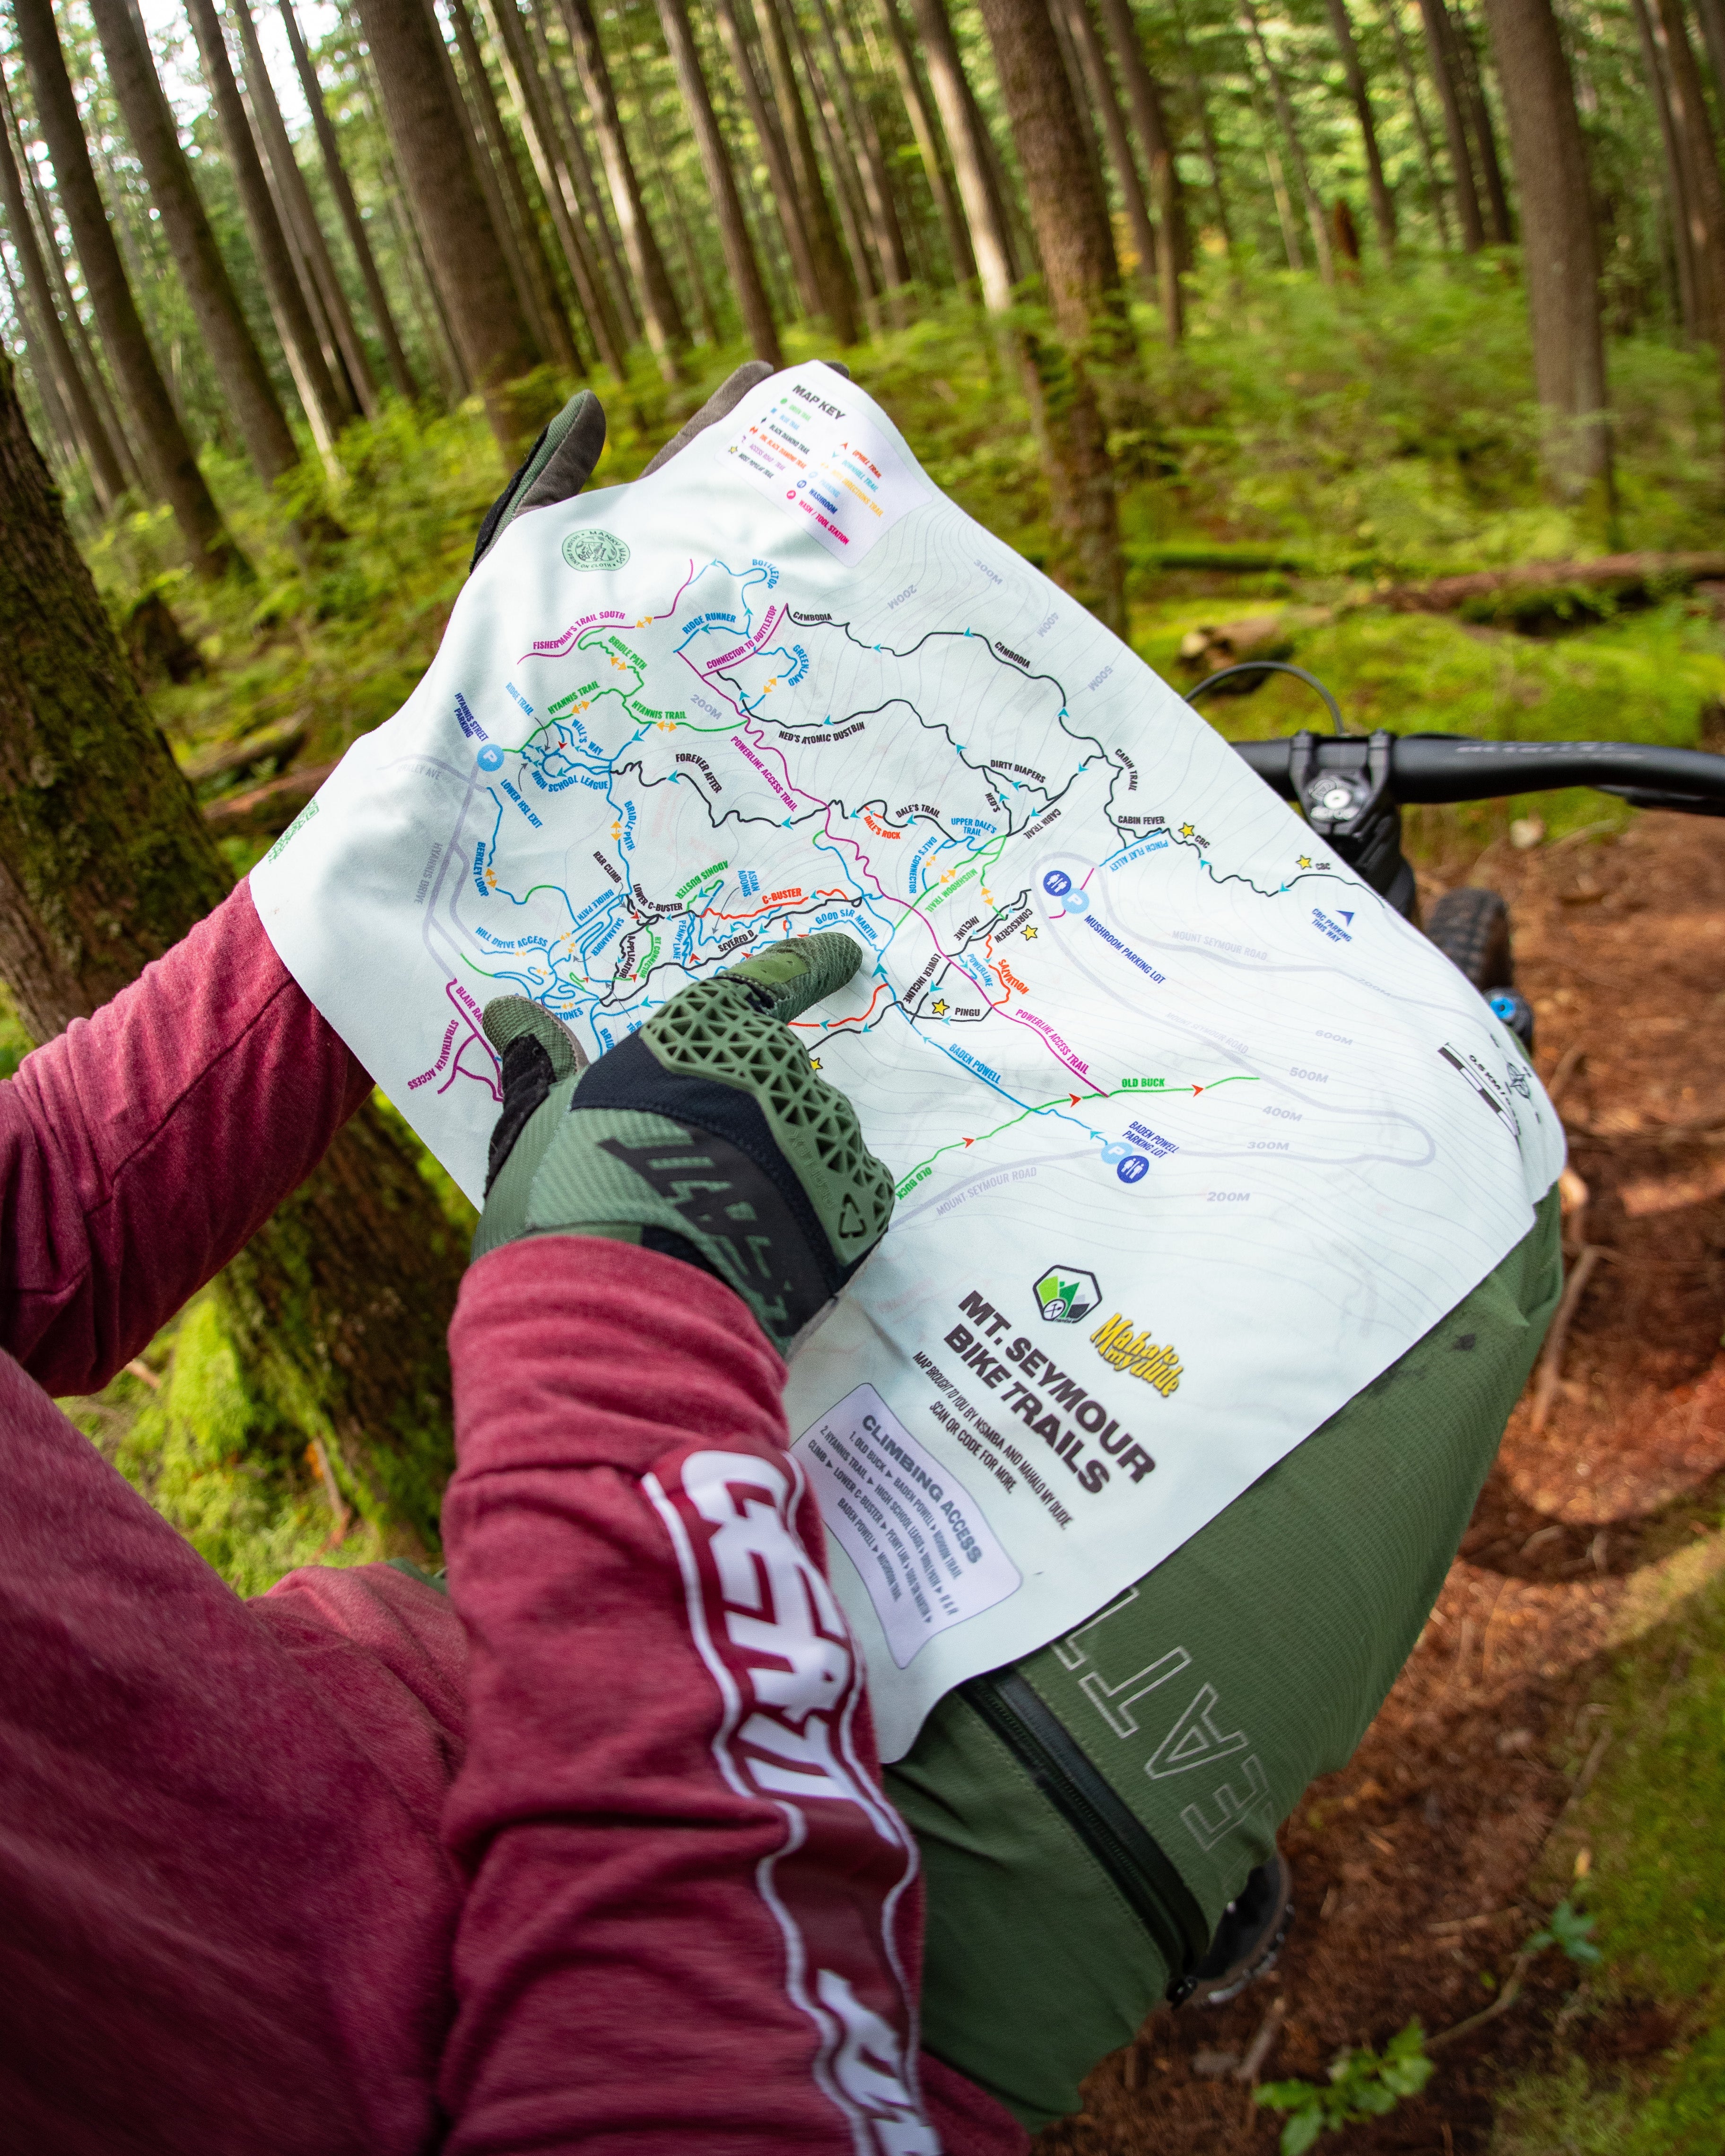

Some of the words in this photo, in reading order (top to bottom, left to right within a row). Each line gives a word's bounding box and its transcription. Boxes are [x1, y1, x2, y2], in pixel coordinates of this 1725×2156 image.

[793, 384, 819, 402] MAP
[819, 402, 845, 419] KEY
[809, 488, 837, 514] WASHROOM
[799, 500, 813, 513] WASH
[816, 514, 829, 528] TOOL
[828, 525, 850, 545] STATION
[752, 559, 779, 589] BOTTLETOP
[533, 626, 577, 649] FISHERMAN'S
[575, 614, 598, 627] TRAIL
[600, 611, 625, 619] SOUTH
[682, 616, 705, 634] RIDGE
[706, 613, 736, 623] RUNNER
[793, 612, 832, 621] CAMBODIA
[706, 646, 746, 669] CONNECTOR
[745, 640, 755, 651] TO
[753, 606, 777, 642] BOTTLETOP
[609, 636, 632, 657] BRIDLE
[630, 650, 648, 670] PATH
[788, 644, 809, 686] GREENLAND
[995, 642, 1031, 669] CAMBODIA
[548, 692, 578, 714] HYANNIS
[577, 681, 600, 695] TRAIL
[631, 701, 662, 719] HYANNIS
[690, 695, 723, 719] 200M
[454, 708, 473, 738] PARKING
[455, 693, 473, 722] HYANNIS
[470, 721, 488, 741] STREET
[572, 719, 587, 743] WILL'S
[588, 742, 603, 756] WAY
[779, 730, 800, 742] NED'S
[802, 734, 831, 744] ATOMIC
[833, 722, 864, 741] DUSTBIN
[532, 770, 547, 790] HIGH
[549, 775, 578, 792] SCHOOL
[581, 775, 608, 790] LEAGUE
[676, 753, 709, 774] FOREVER
[704, 769, 722, 793] AFTER
[731, 736, 765, 770] POWERLINE
[761, 769, 783, 793] ACCESS
[780, 791, 798, 812] TRAIL
[991, 760, 1012, 770] DIRTY
[1014, 765, 1045, 783] DIAPERS
[1115, 748, 1134, 769] CABIN
[1129, 771, 1138, 791] TRAIL
[501, 779, 520, 802] LOWER
[518, 800, 530, 815] HSL
[528, 812, 543, 828] EXIT
[624, 800, 636, 831] BRIDLE
[896, 804, 919, 818] DALE'S
[922, 805, 940, 818] TRAIL
[985, 792, 1001, 812] NED'S
[864, 816, 882, 836] DALE'S
[882, 830, 901, 839] ROCK
[951, 818, 973, 826] UPPER
[975, 820, 997, 834] DALE'S
[1041, 808, 1061, 826] CABIN
[1118, 816, 1141, 824] CABIN
[624, 832, 635, 851] PATH
[963, 827, 981, 836] TRAIL
[1023, 824, 1044, 839] TRAIL
[1194, 835, 1210, 848] CBC
[474, 842, 486, 875] BERKLEY
[593, 851, 608, 865] R&R
[604, 864, 621, 883] CLIMB
[701, 861, 728, 880] ADONIS
[474, 878, 489, 896] LOOP
[675, 876, 702, 899] BUSTER
[738, 870, 752, 897] ADONIS
[747, 870, 760, 891] ASIAN
[909, 855, 921, 894] CONNECTOR
[941, 869, 977, 899] MUSHROOM
[633, 884, 648, 906] LOWER
[648, 903, 682, 912] C-BUSTER
[762, 888, 802, 904] C-BUSTER
[925, 895, 944, 913] TRAIL
[475, 927, 489, 941] HILL
[491, 938, 515, 948] DRIVE
[518, 936, 548, 947] ACCESS
[591, 918, 624, 956] SALAMANDER
[816, 911, 838, 924] GOOD
[855, 915, 878, 940] MARTIN
[954, 916, 979, 941] INCLINE
[994, 909, 1032, 943] CORKSCREW
[1312, 909, 1326, 921] CBC
[1325, 919, 1352, 941] PARKING
[1312, 919, 1327, 932] THIS
[1326, 930, 1341, 942] WAY
[718, 934, 748, 952] SEVERED
[1084, 914, 1124, 951] MUSHROOM
[1121, 947, 1152, 974] PARKING
[1150, 971, 1166, 984] LOT
[1173, 931, 1202, 942] MOUNT
[1204, 936, 1243, 954] SEYMOUR
[1244, 947, 1267, 960] ROAD
[619, 936, 635, 978] APPLICATOR
[923, 954, 941, 976] LOWER
[967, 954, 993, 987] POWERLINE
[903, 975, 927, 1004] INCLINE
[999, 959, 1029, 994] SALVATION
[456, 986, 475, 1009] BLAIR
[955, 1008, 980, 1016] PINGU
[435, 1020, 459, 1071] STRATHAVEN
[1016, 1009, 1054, 1035] POWERLINE
[1049, 1033, 1071, 1056] ACCESS
[1067, 1054, 1089, 1075] TRAIL
[949, 1043, 974, 1064] BADEN
[972, 1059, 1002, 1084] POWELL
[1289, 1067, 1329, 1083] 500M
[408, 1068, 436, 1089] ACCESS
[1122, 1078, 1139, 1087] OLD
[1141, 1078, 1165, 1087] BUCK
[1262, 1105, 1303, 1121] 400M
[1122, 1130, 1155, 1151] PARKING
[1151, 1147, 1167, 1158] LOT
[1129, 1121, 1155, 1139] BADEN
[1151, 1135, 1179, 1154] POWELL
[1246, 1141, 1289, 1151] 300M
[936, 1194, 967, 1216] MOUNT
[968, 1174, 1011, 1198] SEYMOUR
[1011, 1166, 1037, 1180] ROAD
[1207, 1191, 1251, 1201] 200M
[1090, 1313, 1179, 1365] Mahalo
[913, 1351, 932, 1369] MAP
[926, 1365, 951, 1392] BROUGHT
[958, 1290, 1011, 1345] MT.
[1005, 1337, 1157, 1484] SEYMOUR
[946, 1386, 957, 1399] TO
[951, 1393, 970, 1411] YOU
[944, 1323, 1011, 1389] BIKE
[1000, 1381, 1111, 1495] TRAILS
[964, 1407, 979, 1423] BY
[930, 1401, 950, 1423] SCAN
[945, 1417, 961, 1436] QR
[958, 1429, 983, 1456] CODE
[979, 1449, 998, 1472] FOR
[973, 1417, 1006, 1450] NSMBA
[808, 1439, 827, 1462] CLIMB
[1003, 1445, 1023, 1466] AND
[861, 1415, 944, 1503] CLIMBING
[940, 1499, 983, 1564] ACCESS
[1017, 1461, 1046, 1494] MAHALO
[1040, 1488, 1054, 1505] MY
